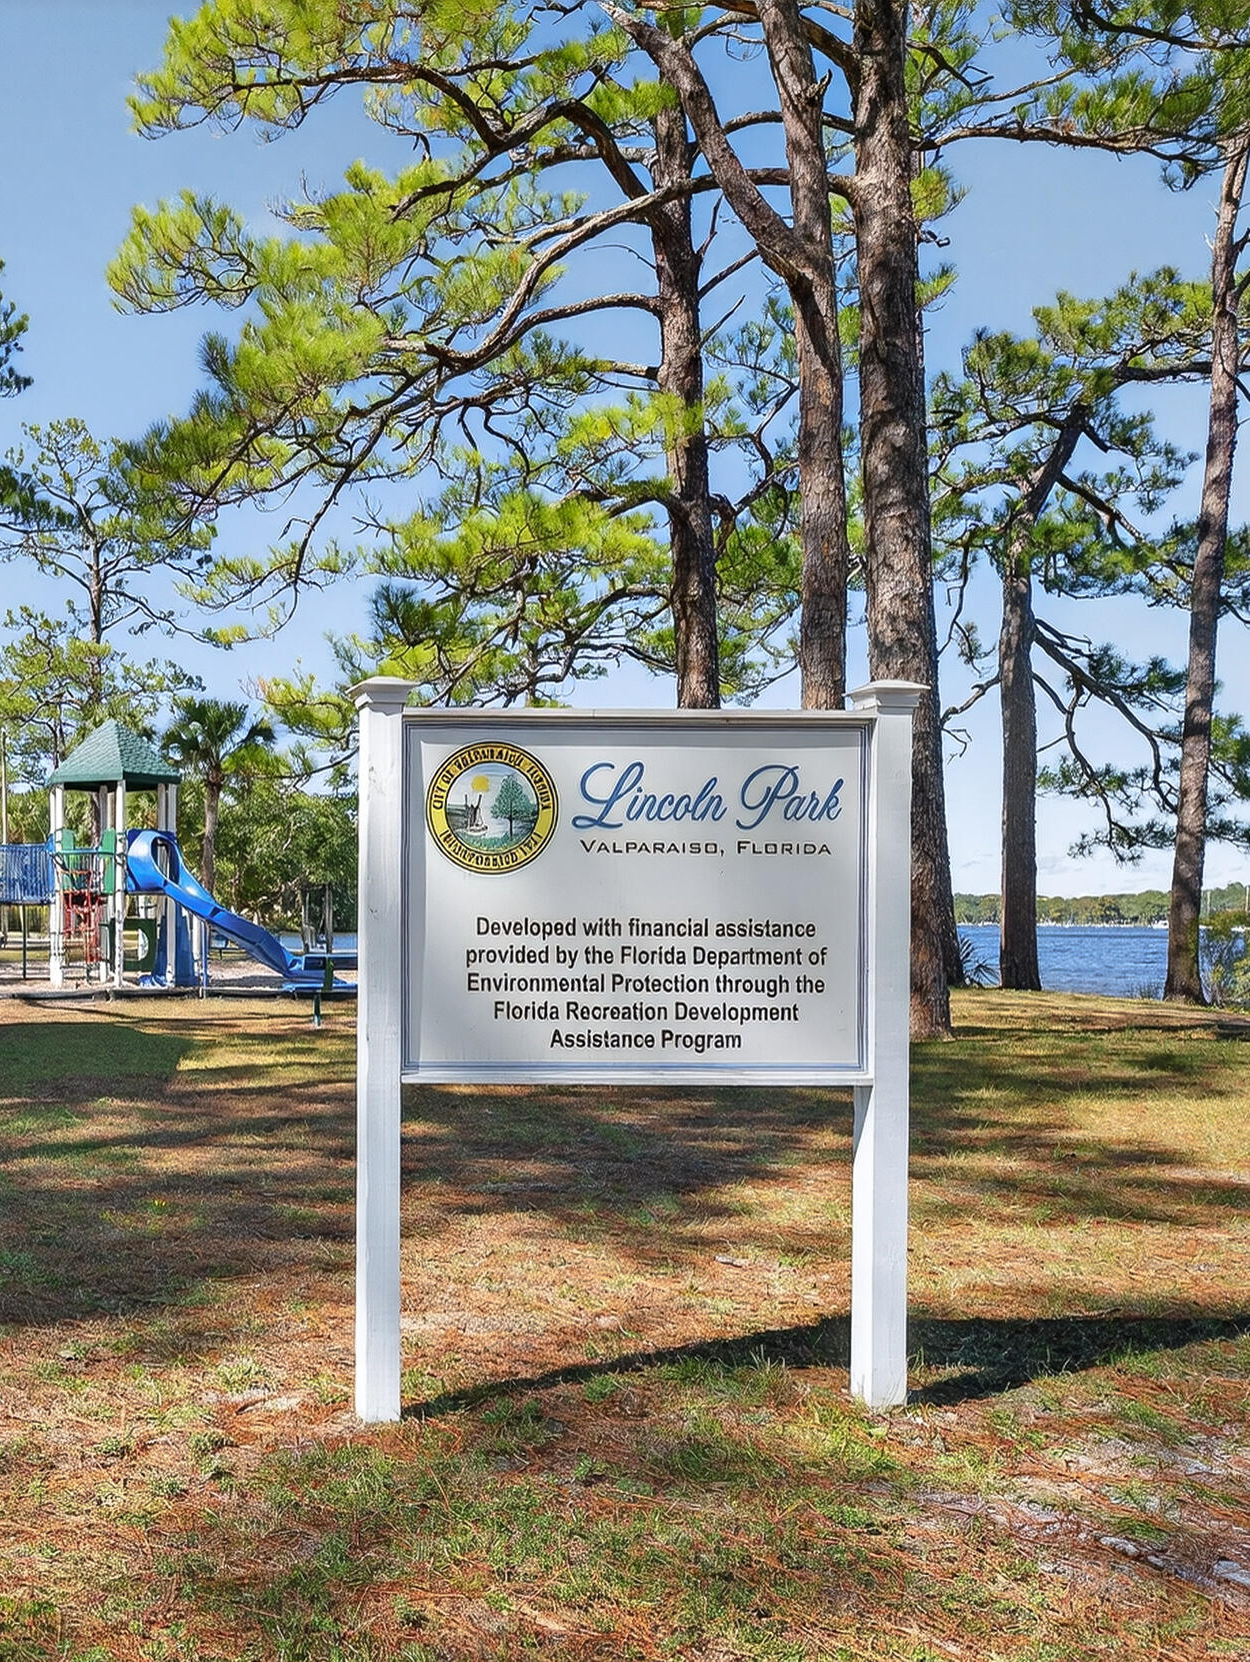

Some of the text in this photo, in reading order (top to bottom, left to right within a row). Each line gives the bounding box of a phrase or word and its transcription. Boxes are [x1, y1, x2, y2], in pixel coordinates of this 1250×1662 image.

[571, 761, 844, 830] Lincoln Park
[579, 839, 832, 857] VALPARAISO, FLORIDA
[476, 916, 816, 940] Developed with financial assistance
[466, 944, 828, 970] provided by the Florida Department of
[467, 973, 826, 998] Environmental Protection through the
[493, 1001, 799, 1025] Florida Recreation Development
[549, 1028, 742, 1053] Assistance Program
